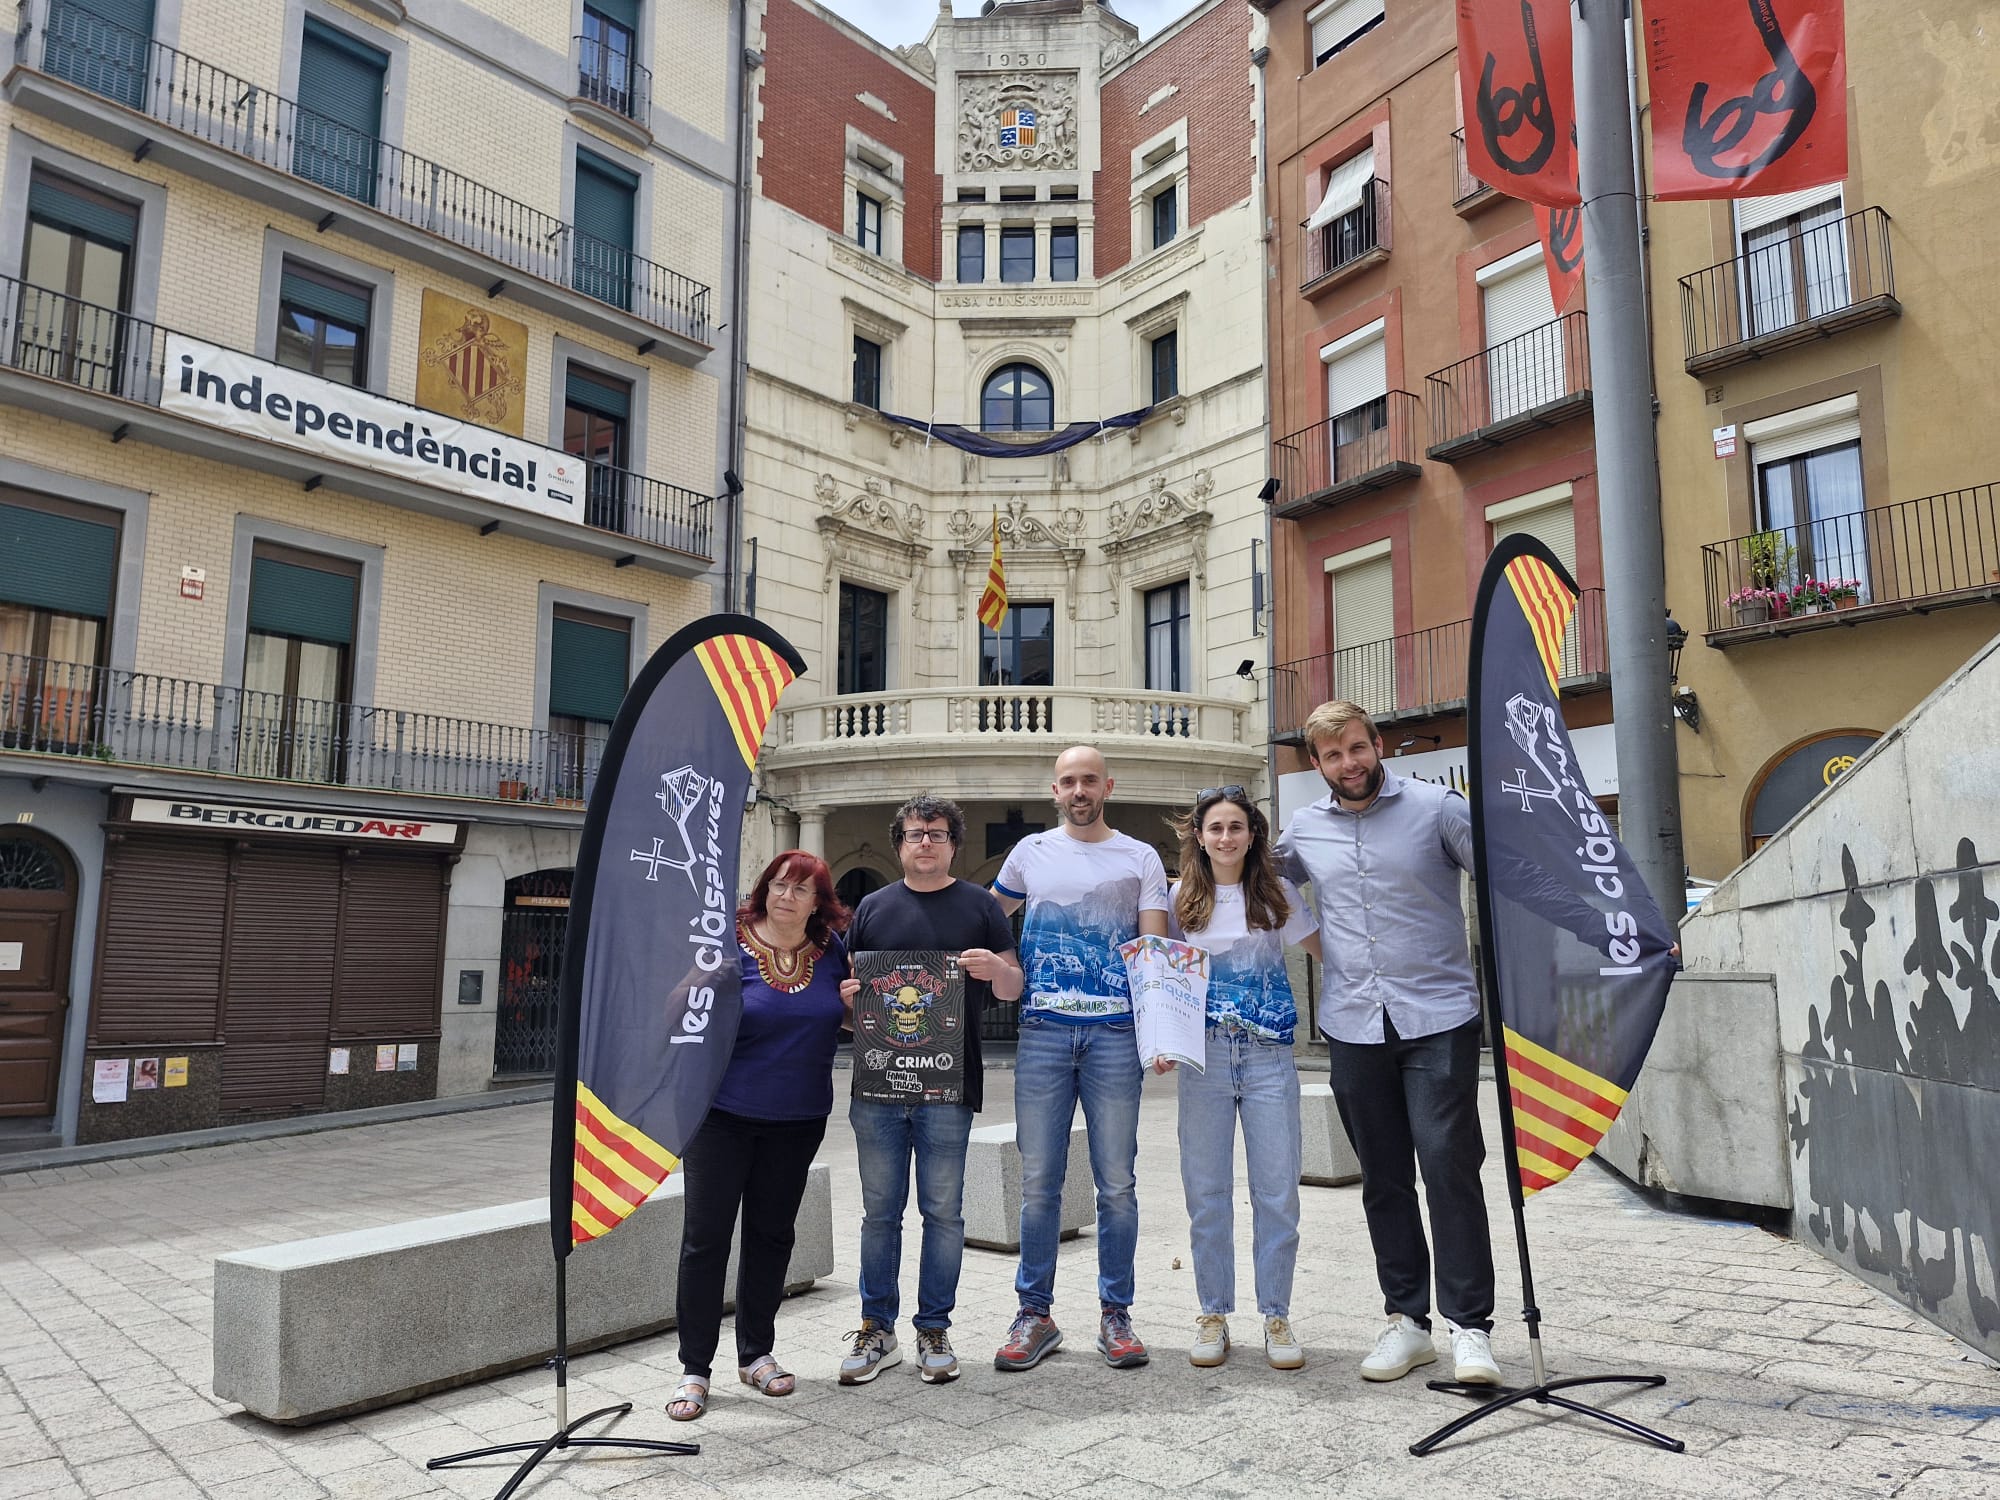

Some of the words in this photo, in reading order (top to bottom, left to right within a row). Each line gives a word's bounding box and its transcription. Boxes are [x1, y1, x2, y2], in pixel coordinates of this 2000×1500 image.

[987, 53, 1047, 67] 1930
[943, 296, 981, 308] CASA
[986, 293, 1092, 307] CONSISTORIAL
[180, 355, 537, 493] independència!
[169, 803, 431, 839] BERGUEDART
[1599, 910, 1643, 976] les
[871, 970, 905, 996] PUNK
[669, 985, 715, 1044] les
[895, 1056, 935, 1069] CRIM
